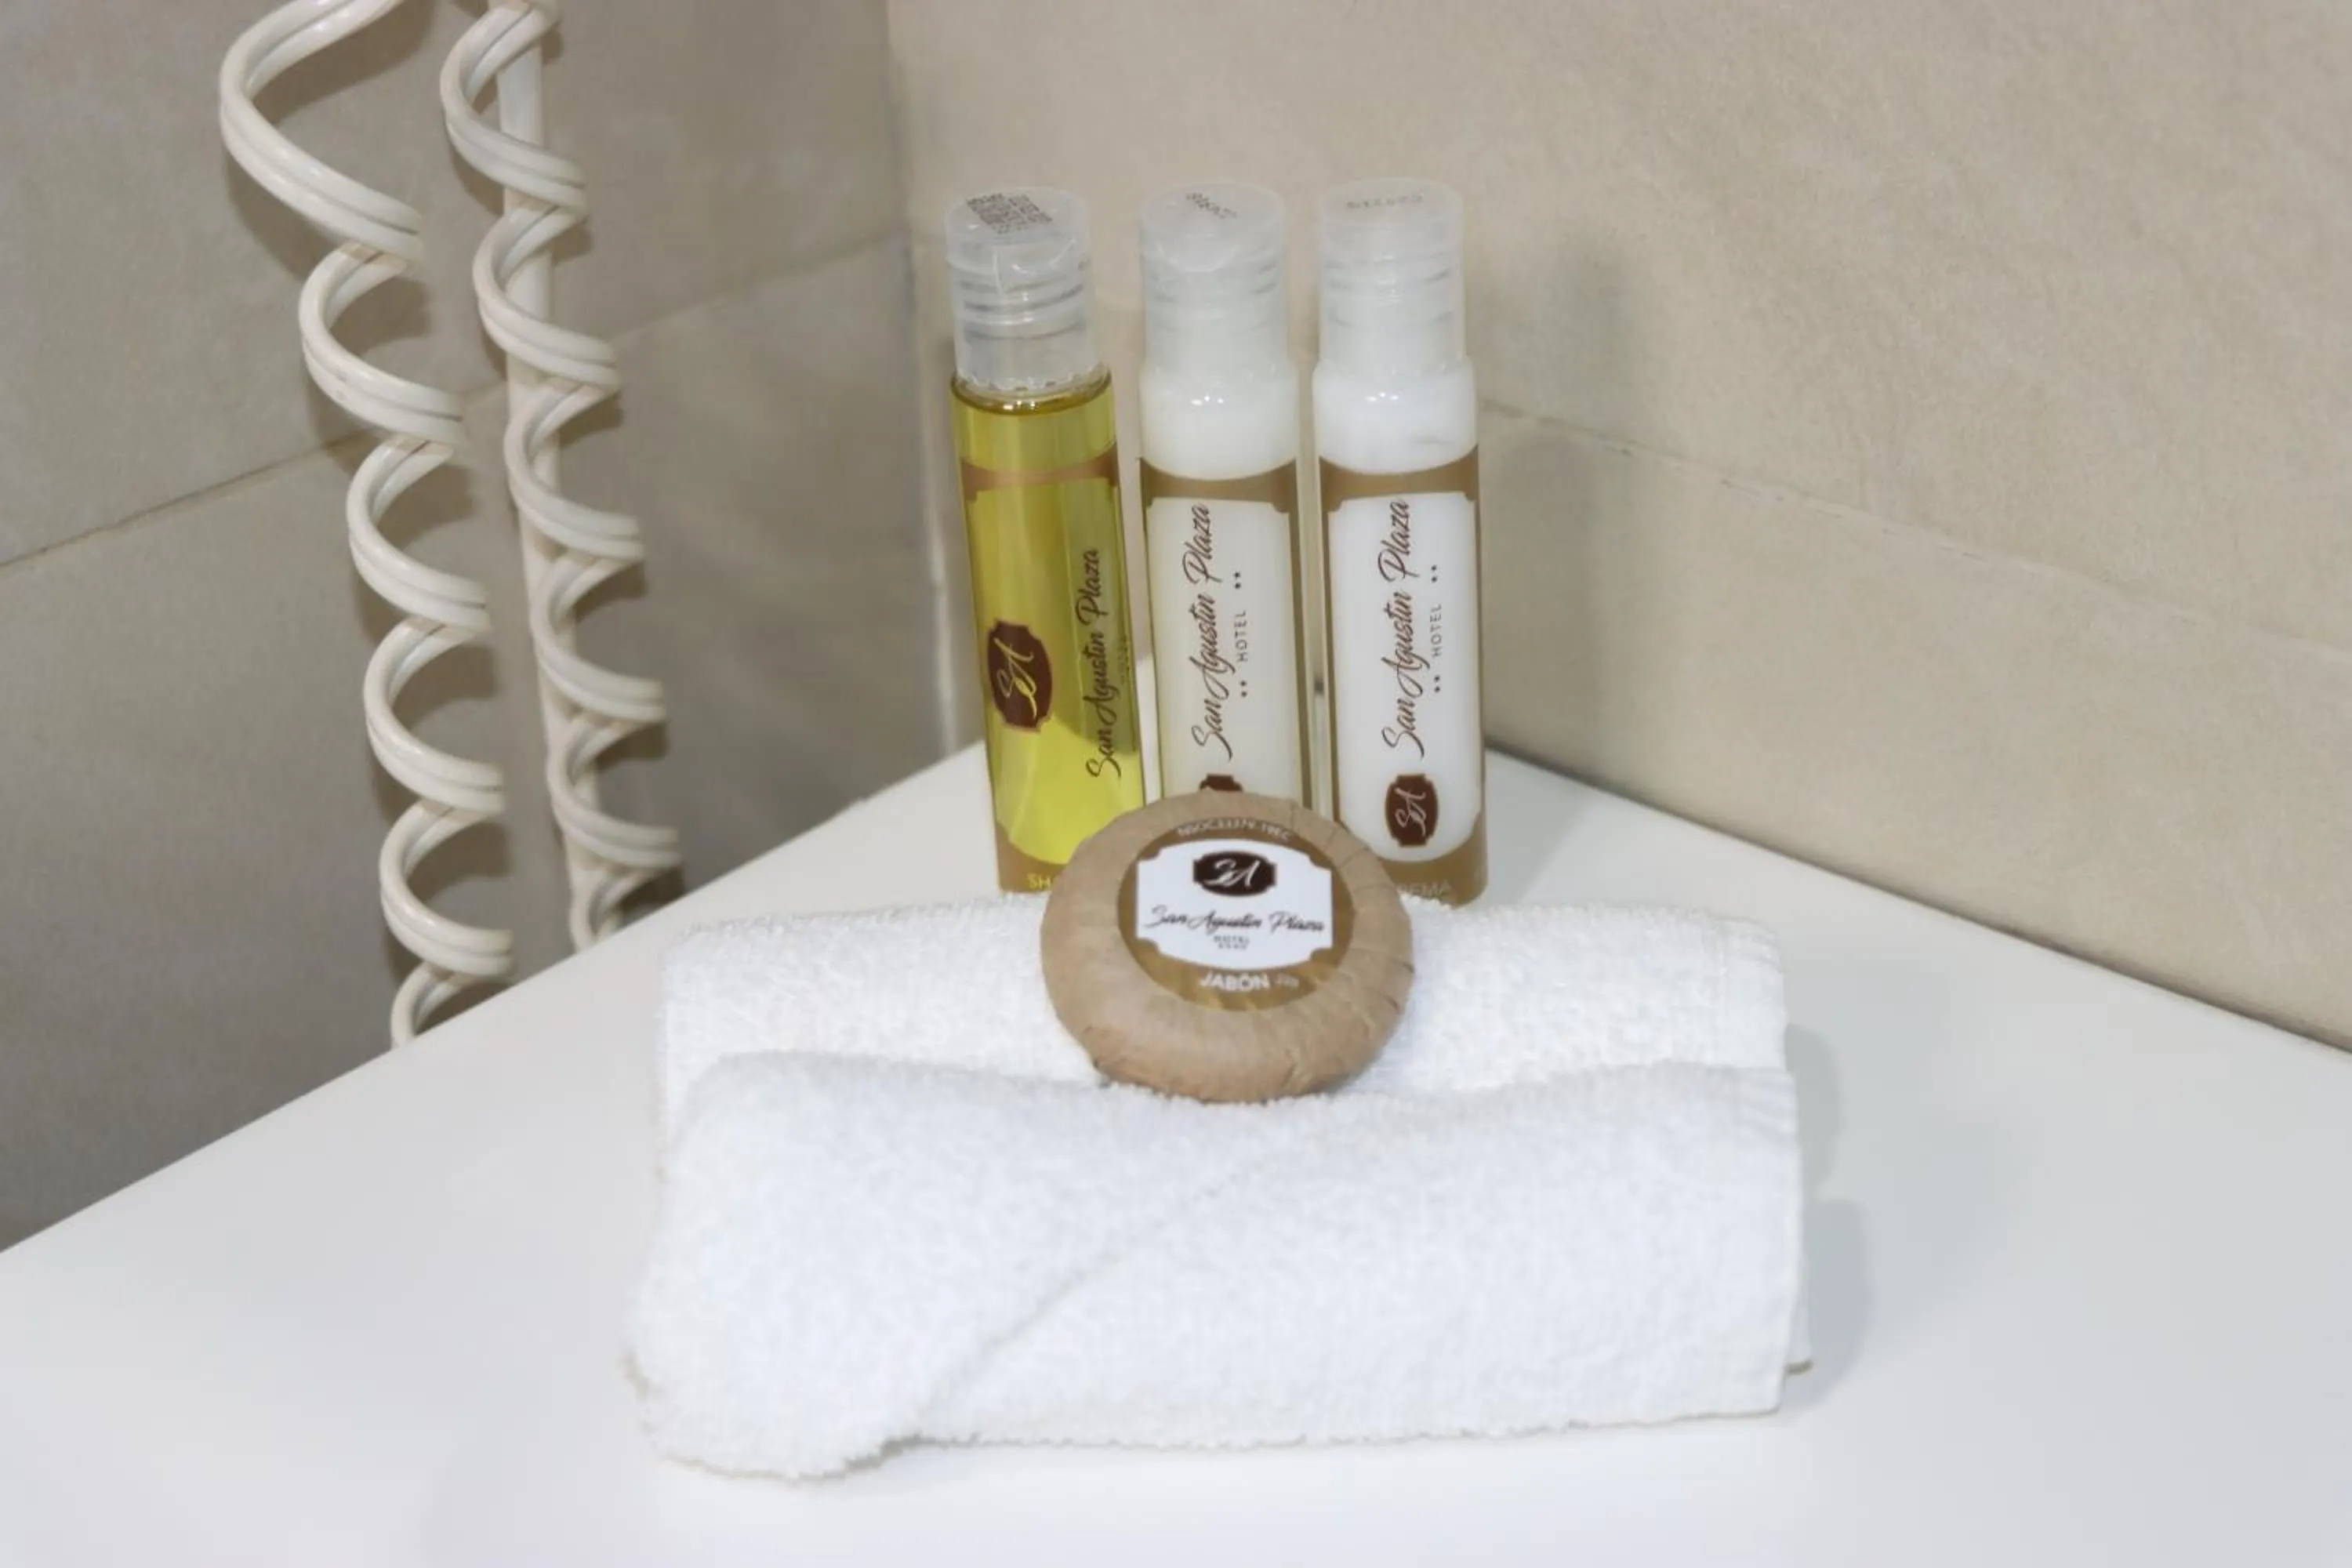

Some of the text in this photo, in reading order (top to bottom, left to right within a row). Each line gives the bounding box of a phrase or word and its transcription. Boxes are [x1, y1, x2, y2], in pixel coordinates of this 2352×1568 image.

[1181, 503, 1223, 584] Plaza
[1377, 499, 1420, 582] Plaza
[1075, 549, 1108, 625] Plaza
[1235, 611, 1248, 662] HOTEL
[1431, 603, 1443, 658] HOTEL
[1085, 728, 1122, 779] San
[1189, 698, 1233, 762] San
[1381, 698, 1425, 759] San
